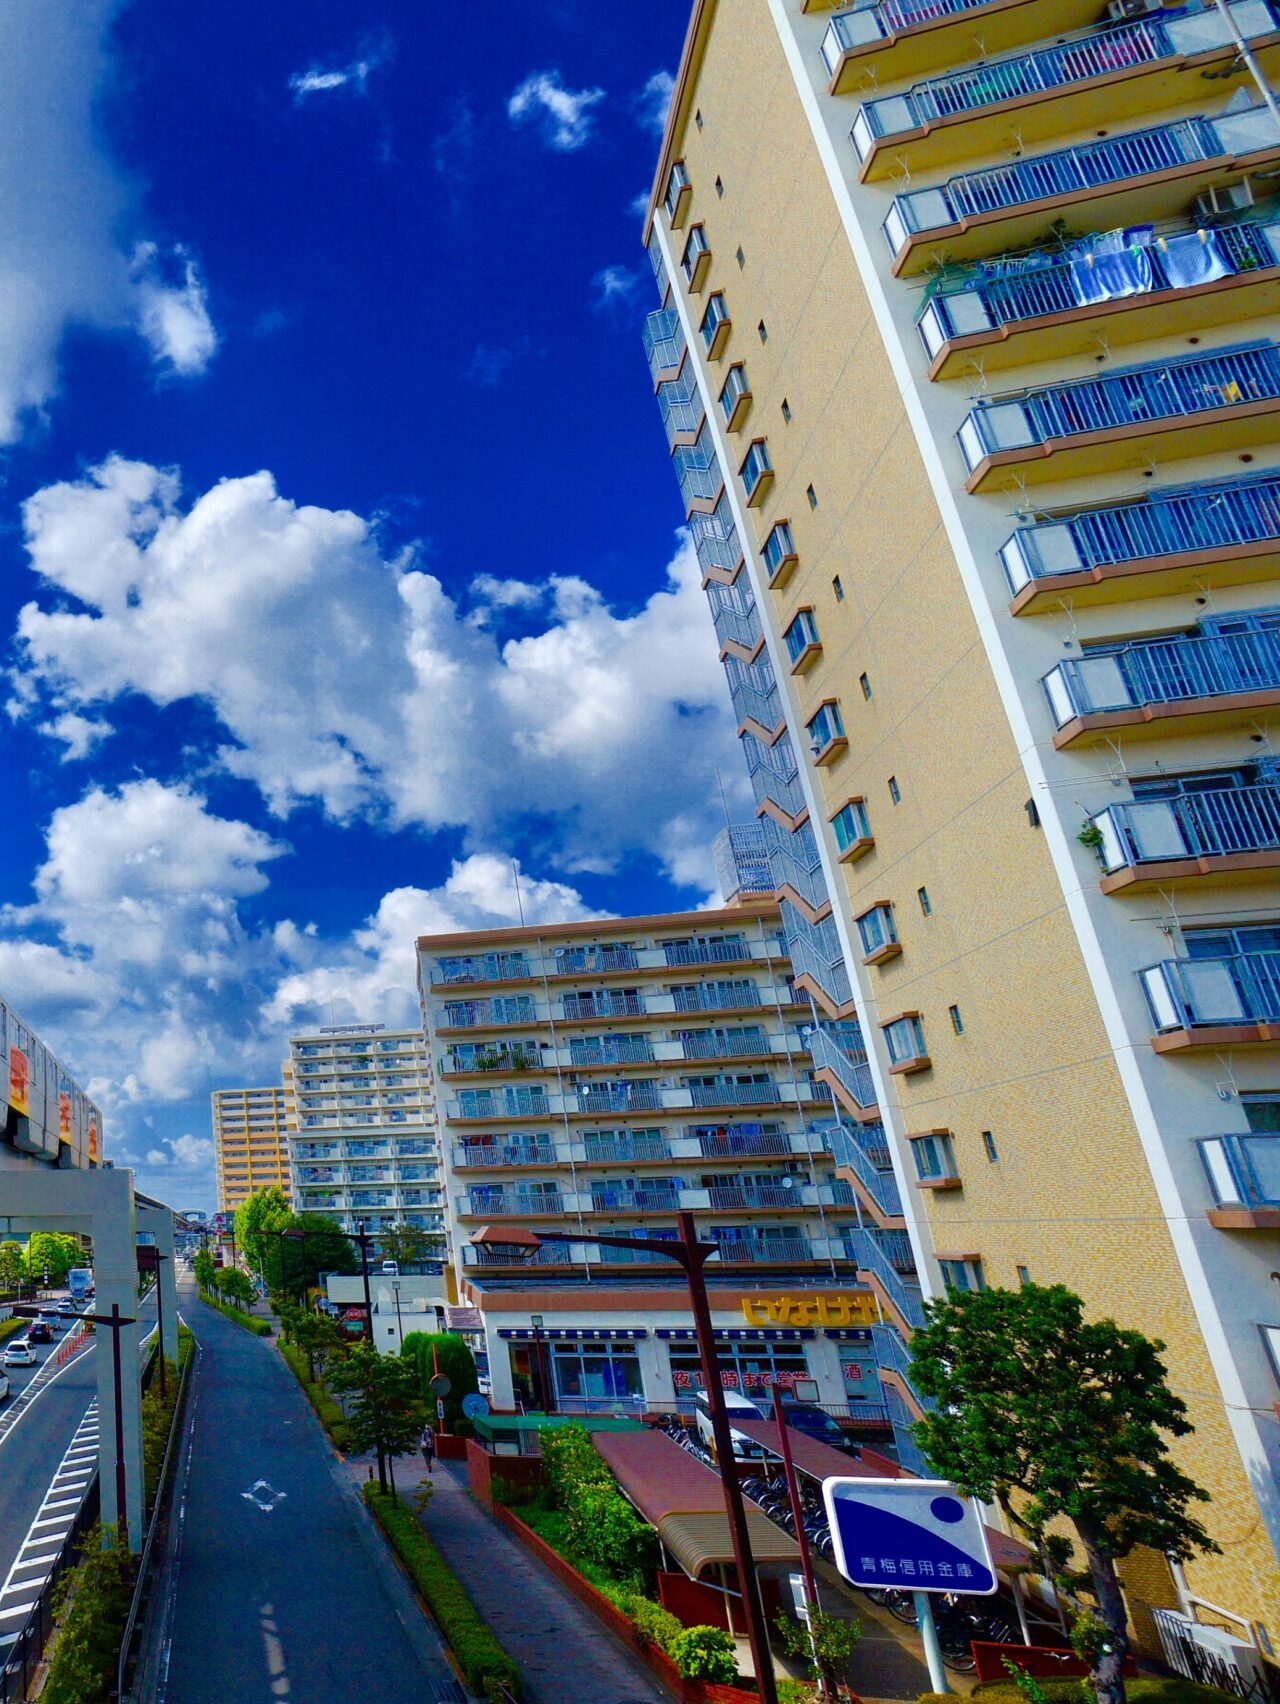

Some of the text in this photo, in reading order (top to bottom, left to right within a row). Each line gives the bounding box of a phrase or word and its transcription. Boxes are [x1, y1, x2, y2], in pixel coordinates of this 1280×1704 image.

[860, 1557, 973, 1578] 青梅信用金庫
